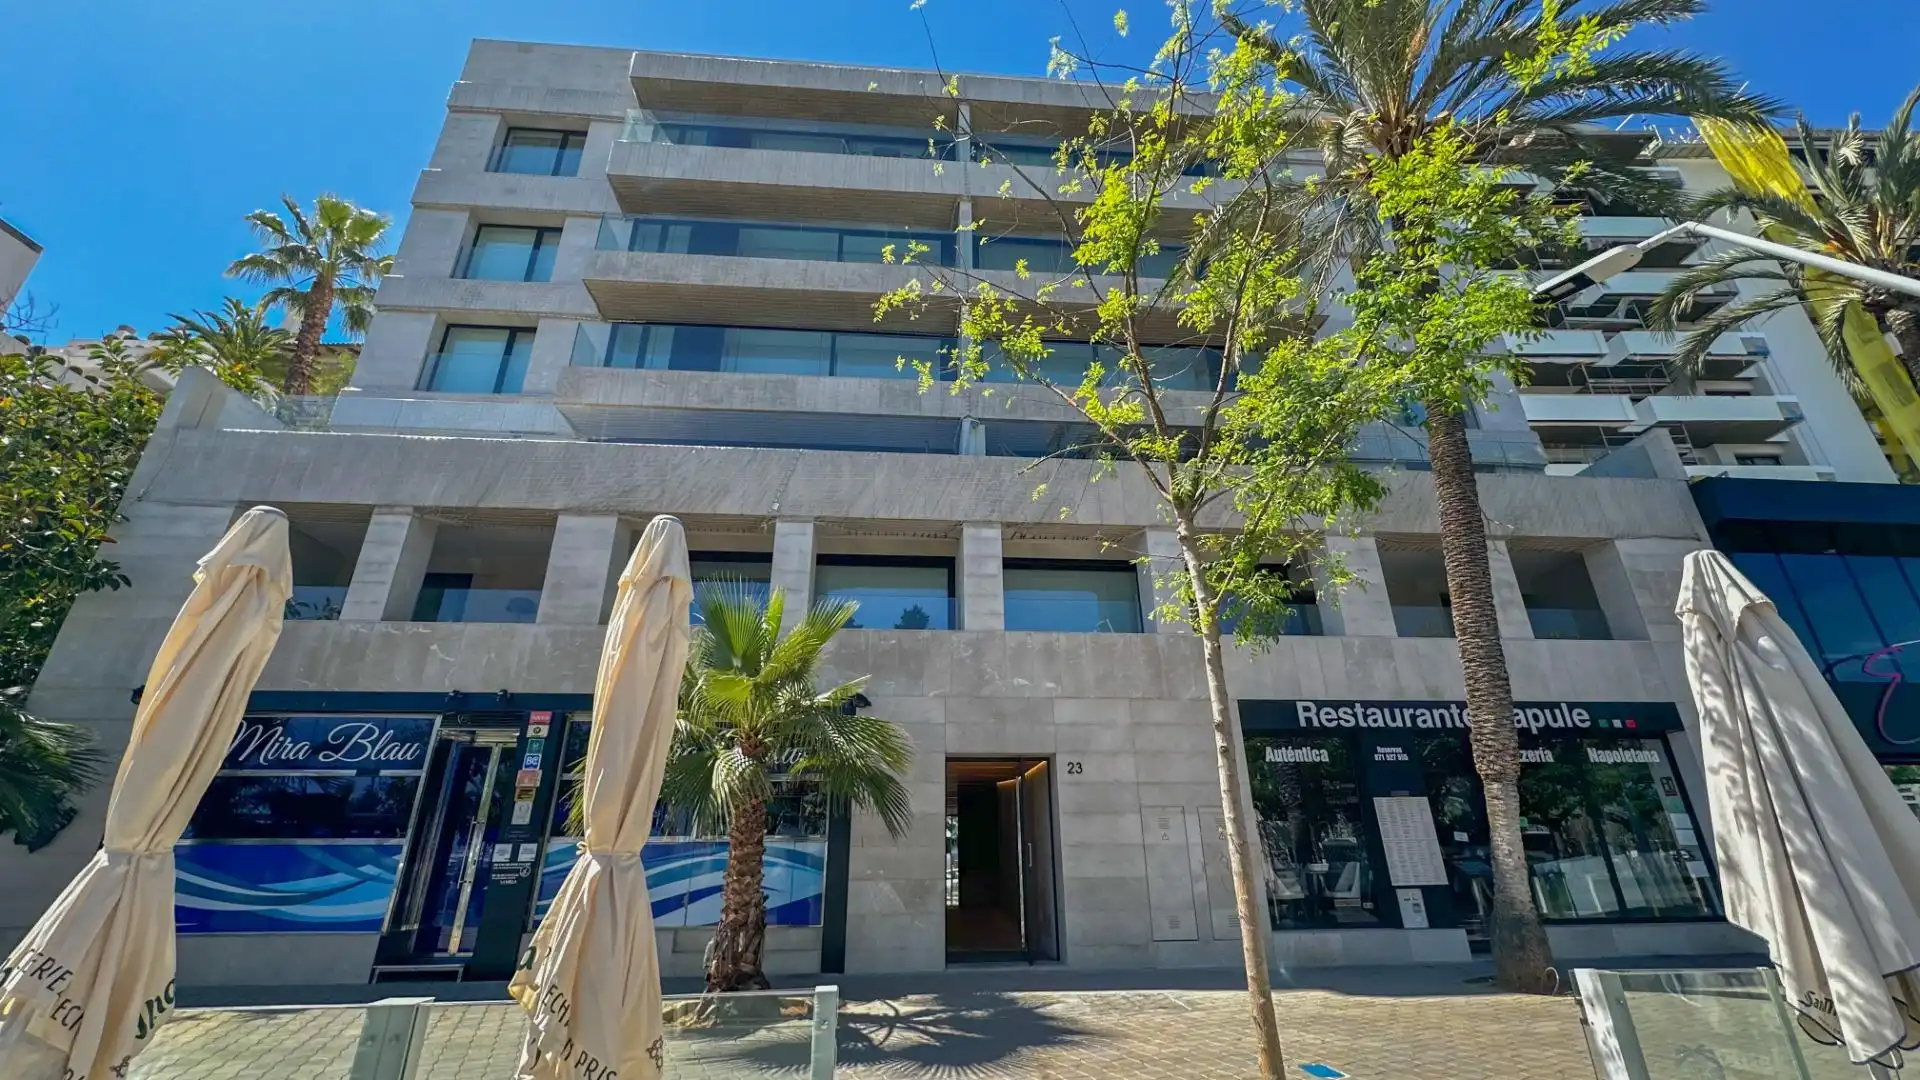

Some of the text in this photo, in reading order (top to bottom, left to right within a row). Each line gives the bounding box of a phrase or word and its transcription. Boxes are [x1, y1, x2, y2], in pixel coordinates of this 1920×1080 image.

[1513, 702, 1592, 735] apule
[229, 719, 421, 765] Mira Blau
[1265, 745, 1330, 763] Auténtica
[1586, 746, 1661, 764] Napoletana
[1067, 761, 1083, 775] 23
